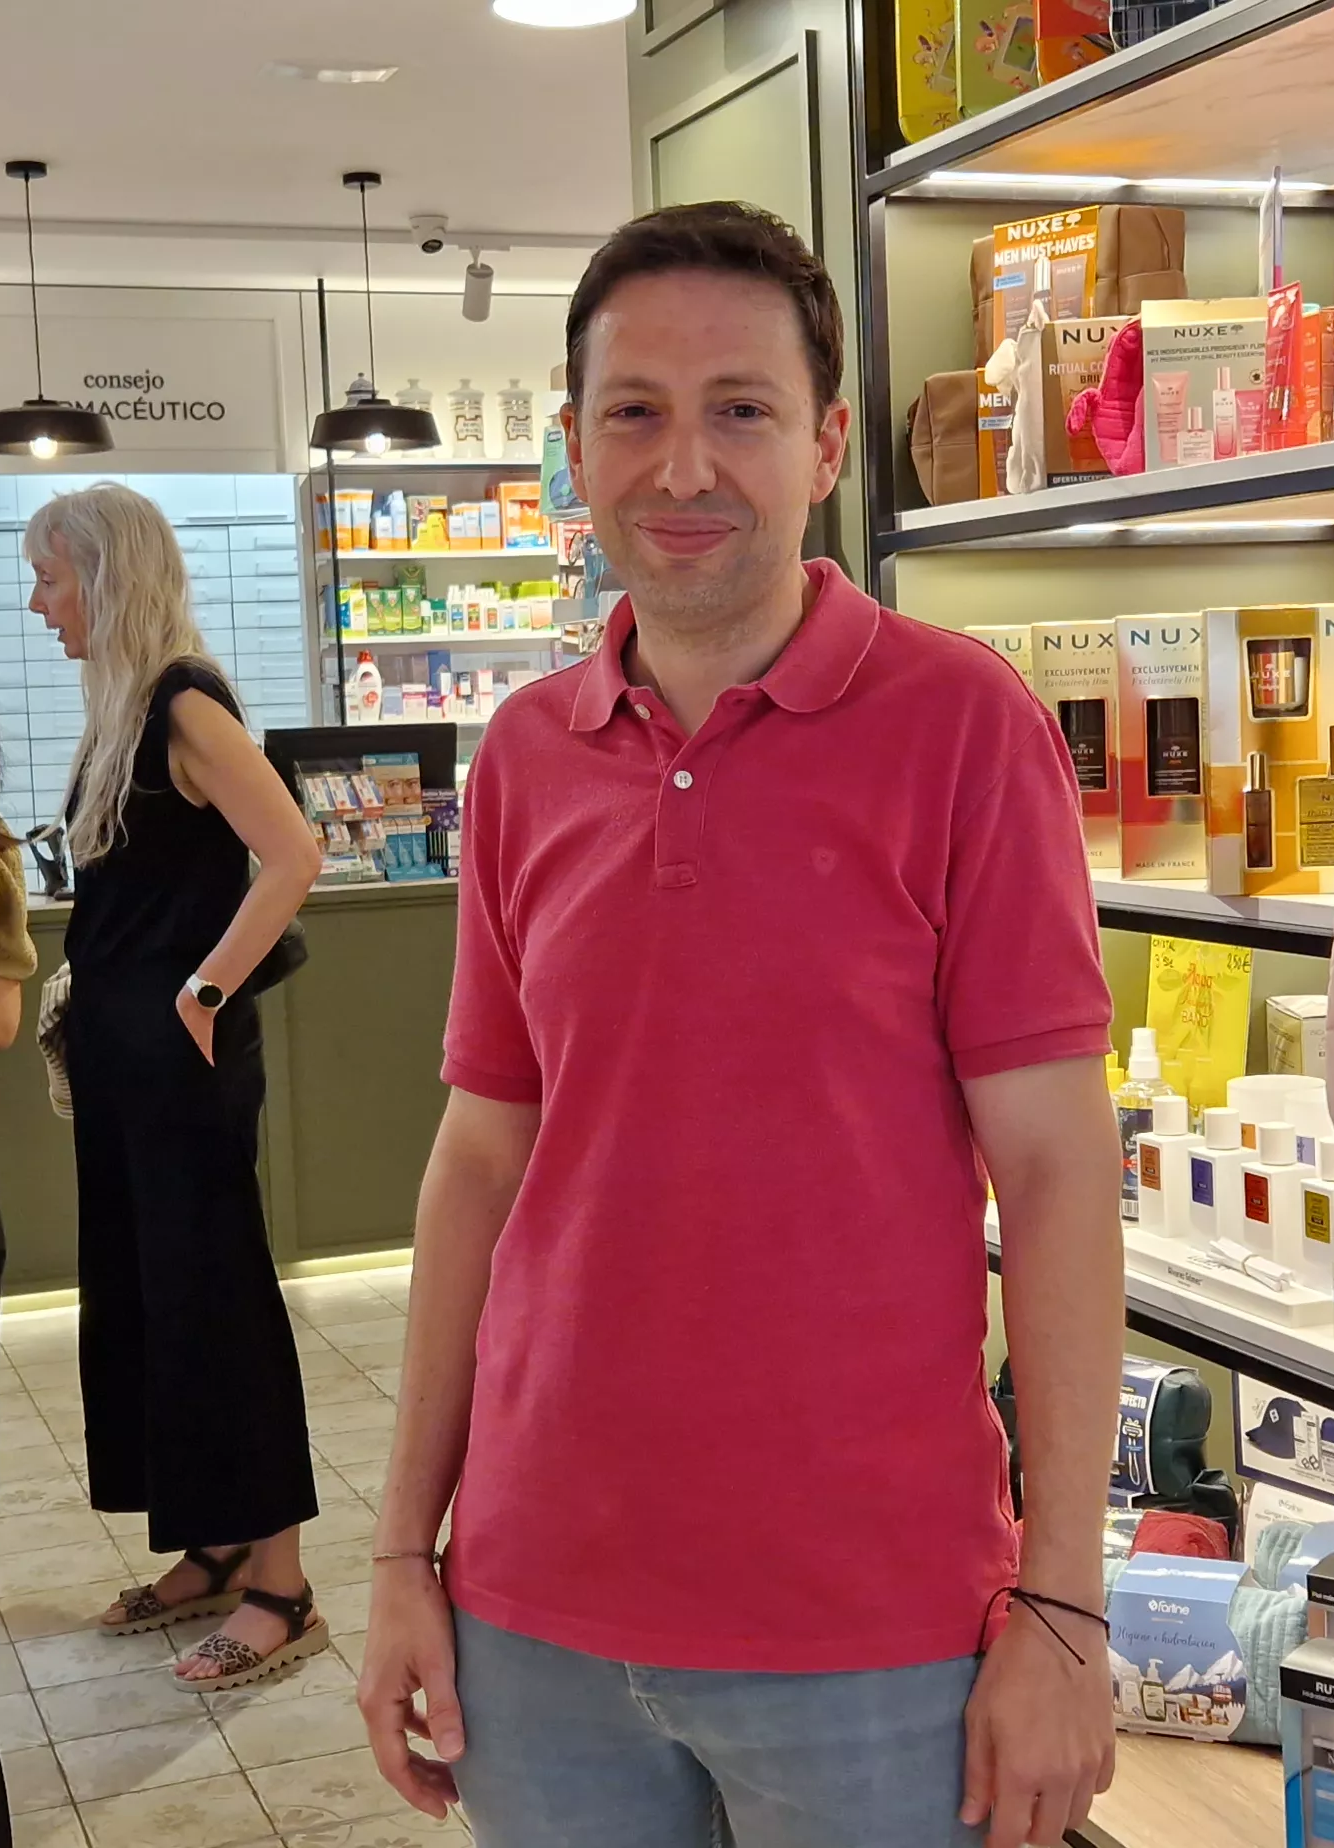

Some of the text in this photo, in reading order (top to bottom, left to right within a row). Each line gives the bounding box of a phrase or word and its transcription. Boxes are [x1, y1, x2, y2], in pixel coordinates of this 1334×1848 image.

[1007, 216, 1064, 241] NUXE
[994, 233, 1096, 268] MEN MUST-HAVES
[1063, 326, 1118, 344] NU
[1174, 326, 1228, 338] NUXE
[1049, 362, 1087, 375] RITUAL
[83, 368, 165, 393] consejo
[62, 397, 226, 421] MACÉUTICO
[979, 393, 1012, 408] MEN
[1044, 633, 1114, 650] NUX
[1130, 628, 1201, 646] NUX
[1045, 667, 1111, 677] EXCLUSIVEMENT
[1132, 664, 1200, 674] EXCLUSIVEMEN
[1168, 860, 1195, 868] FRANCE
[1157, 1600, 1190, 1616] farline
[1117, 1626, 1152, 1646] Higiene
